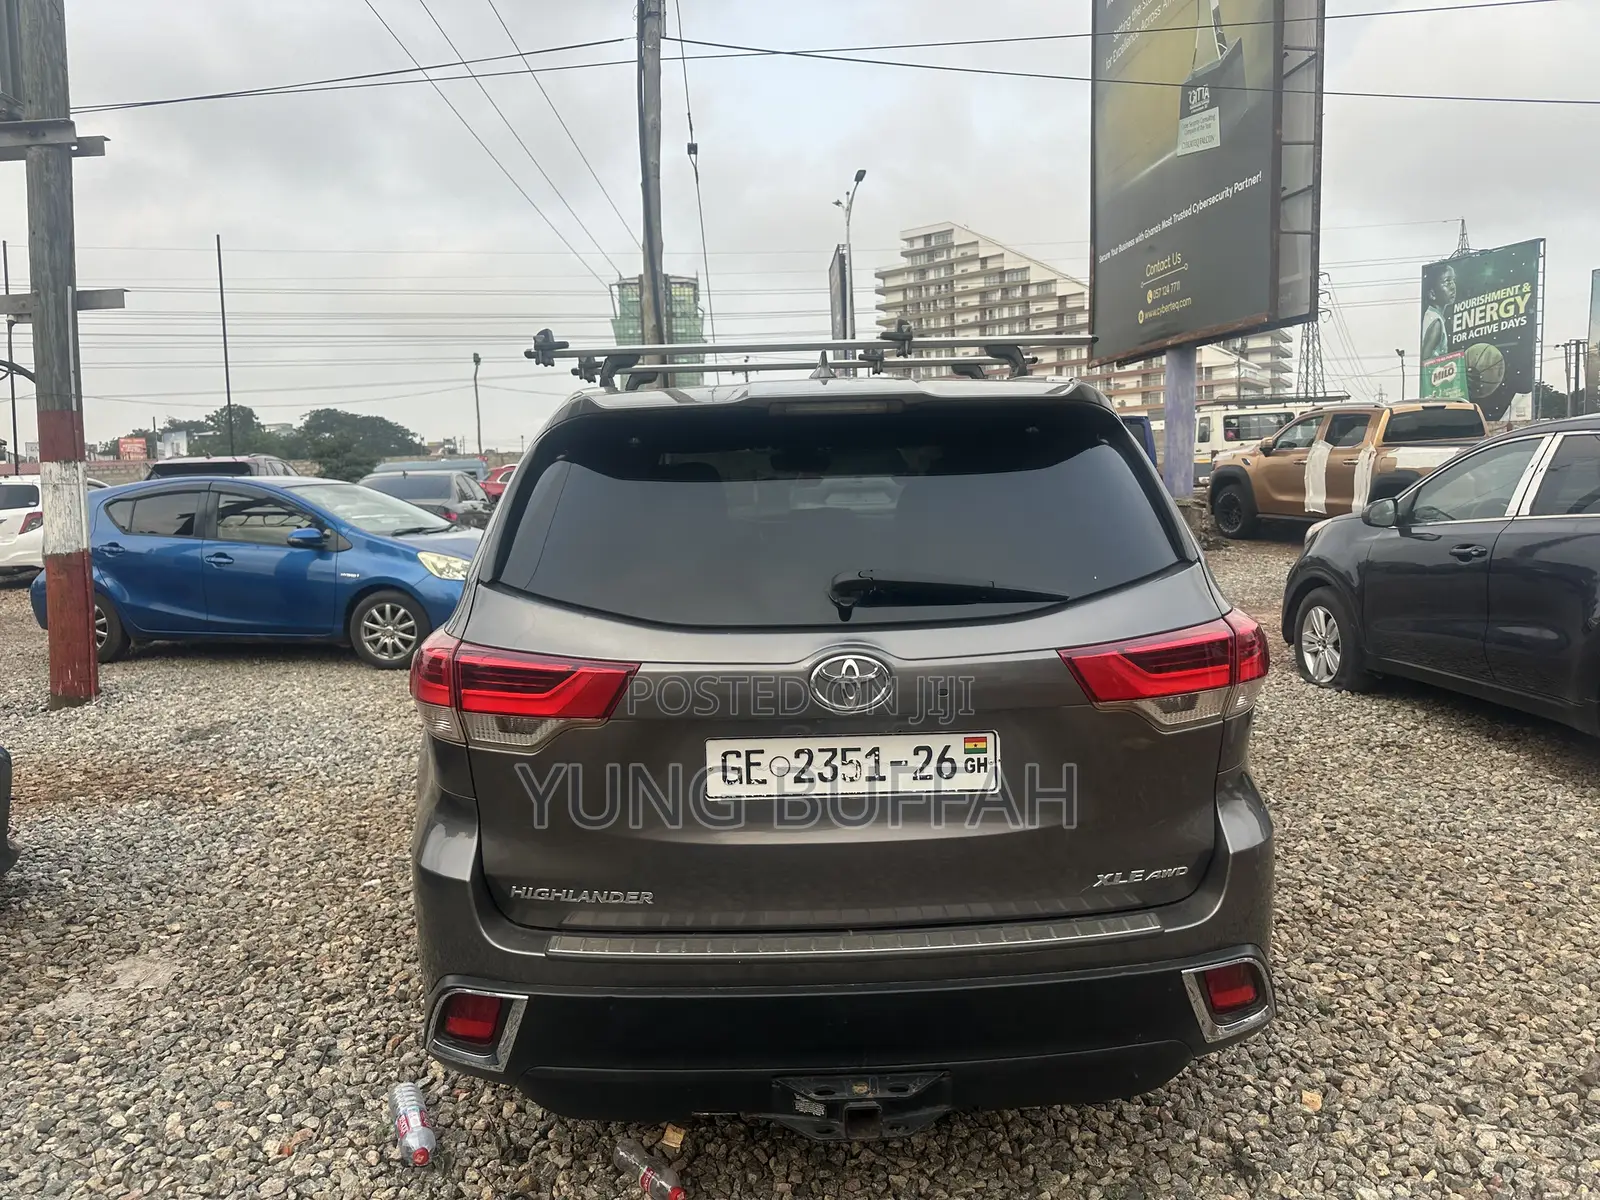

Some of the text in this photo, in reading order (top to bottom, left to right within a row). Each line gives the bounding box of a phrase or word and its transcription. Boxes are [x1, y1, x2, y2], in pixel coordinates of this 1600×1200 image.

[1113, 16, 1132, 42] Setting
[1132, 5, 1142, 22] the
[1113, 28, 1140, 63] Excellence
[1141, 5, 1162, 31] Across
[1099, 252, 1110, 264] Secure
[1119, 239, 1135, 253] Business
[1135, 232, 1144, 243] with
[1144, 223, 1161, 239] Ghana's
[1162, 217, 1172, 230] Most
[1173, 205, 1192, 224] Trusted
[1192, 186, 1233, 214] Cybersecurity
[1234, 171, 1262, 194] Partner!
[1146, 252, 1181, 277] Contact Us
[1144, 296, 1192, 320] www.cyberteq.com
[1454, 282, 1531, 313] NOURISHMENT &
[1452, 293, 1531, 333] ENERGY
[1452, 316, 1527, 344] FOR ACTIVE DAYS
[1433, 367, 1455, 382] MILO
[721, 748, 766, 787] GE
[964, 757, 989, 774] GH
[1092, 866, 1189, 888] XLE AWD
[510, 885, 654, 905] HIGHLANDER
